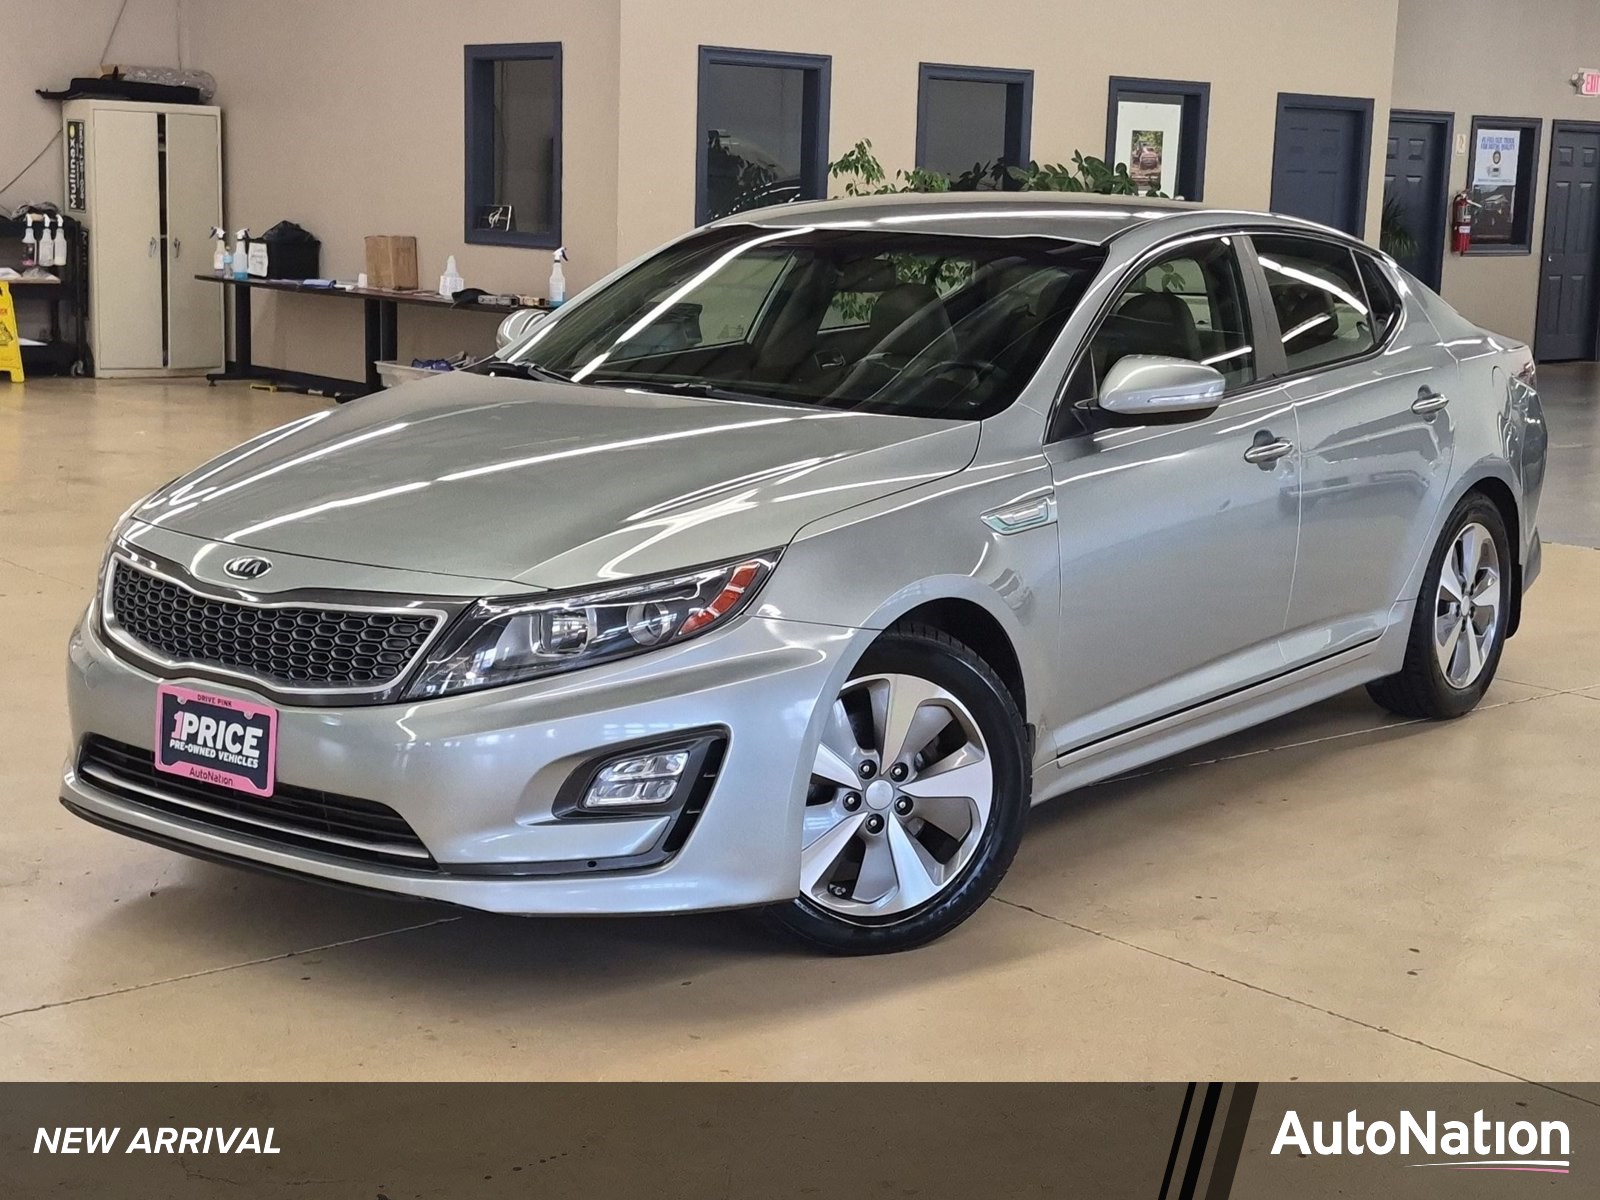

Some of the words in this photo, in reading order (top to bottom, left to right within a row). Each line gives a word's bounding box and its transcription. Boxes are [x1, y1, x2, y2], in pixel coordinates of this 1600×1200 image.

[69, 138, 77, 209] Mullinax
[197, 693, 217, 704] DRIVE
[217, 698, 232, 707] PINK
[169, 738, 216, 758] PRE-OWNED
[218, 750, 259, 769] VEHICLES
[188, 767, 234, 786] AutoNation
